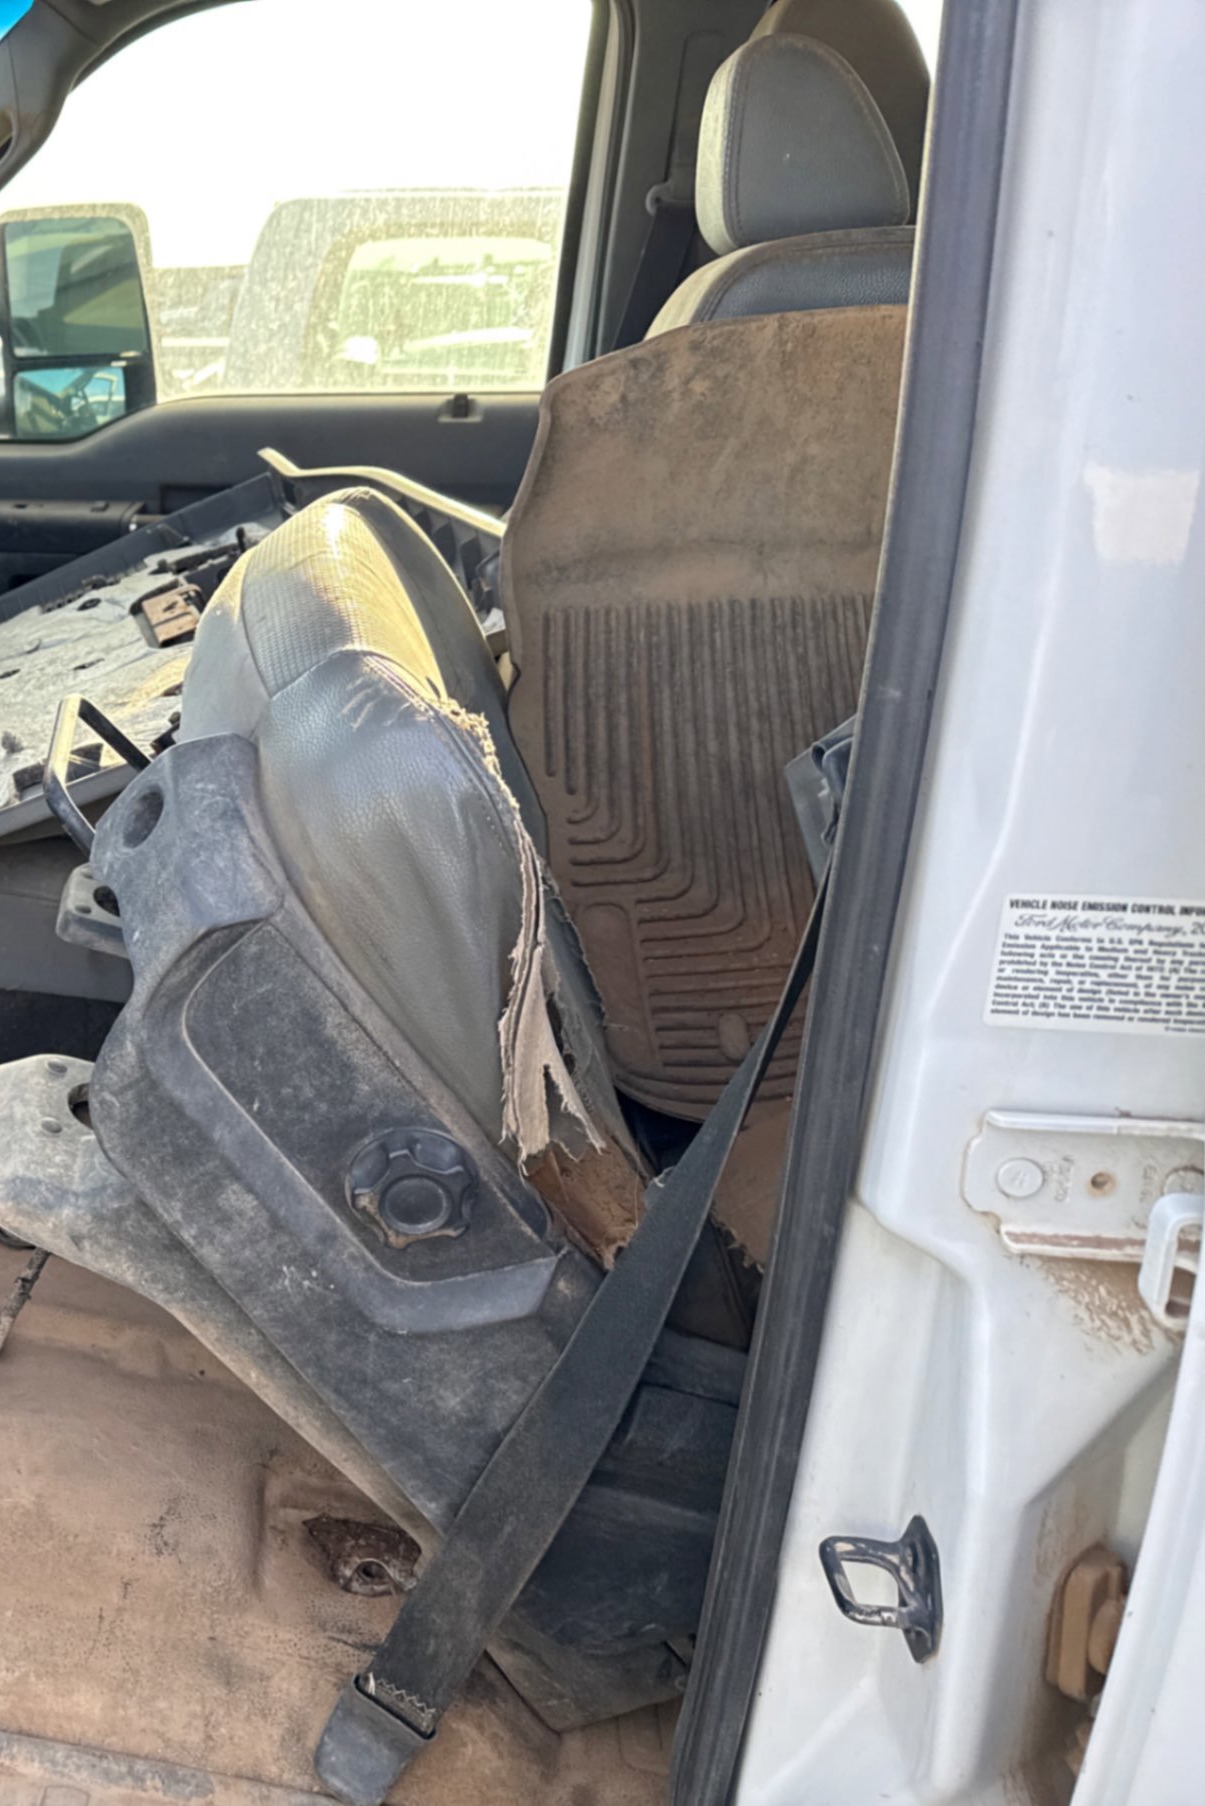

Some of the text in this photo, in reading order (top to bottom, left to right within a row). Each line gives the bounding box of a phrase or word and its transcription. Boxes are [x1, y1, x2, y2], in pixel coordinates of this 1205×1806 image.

[1010, 898, 1048, 910] VEHICLE
[1051, 900, 1079, 912] NOISE
[1081, 901, 1128, 913] EMISSION
[1131, 903, 1175, 915] CONTROL
[1014, 913, 1057, 928] Ford
[1048, 914, 1102, 933] Motor
